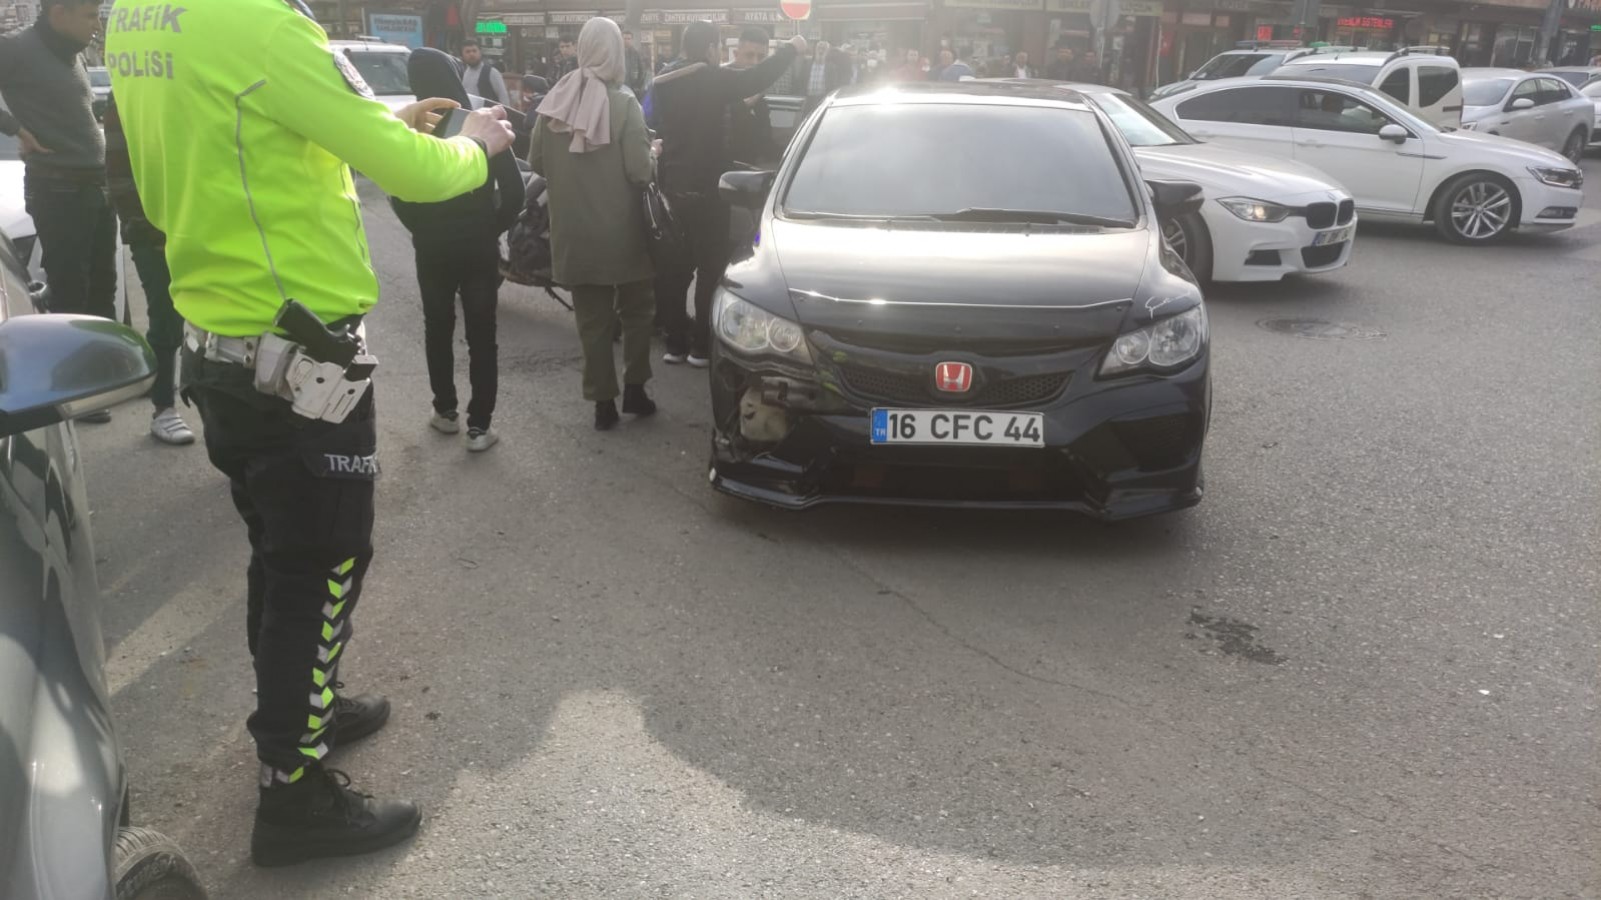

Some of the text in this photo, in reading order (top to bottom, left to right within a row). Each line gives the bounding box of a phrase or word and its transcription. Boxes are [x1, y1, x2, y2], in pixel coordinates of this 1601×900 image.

[889, 413, 1040, 443] 16 CFC 44
